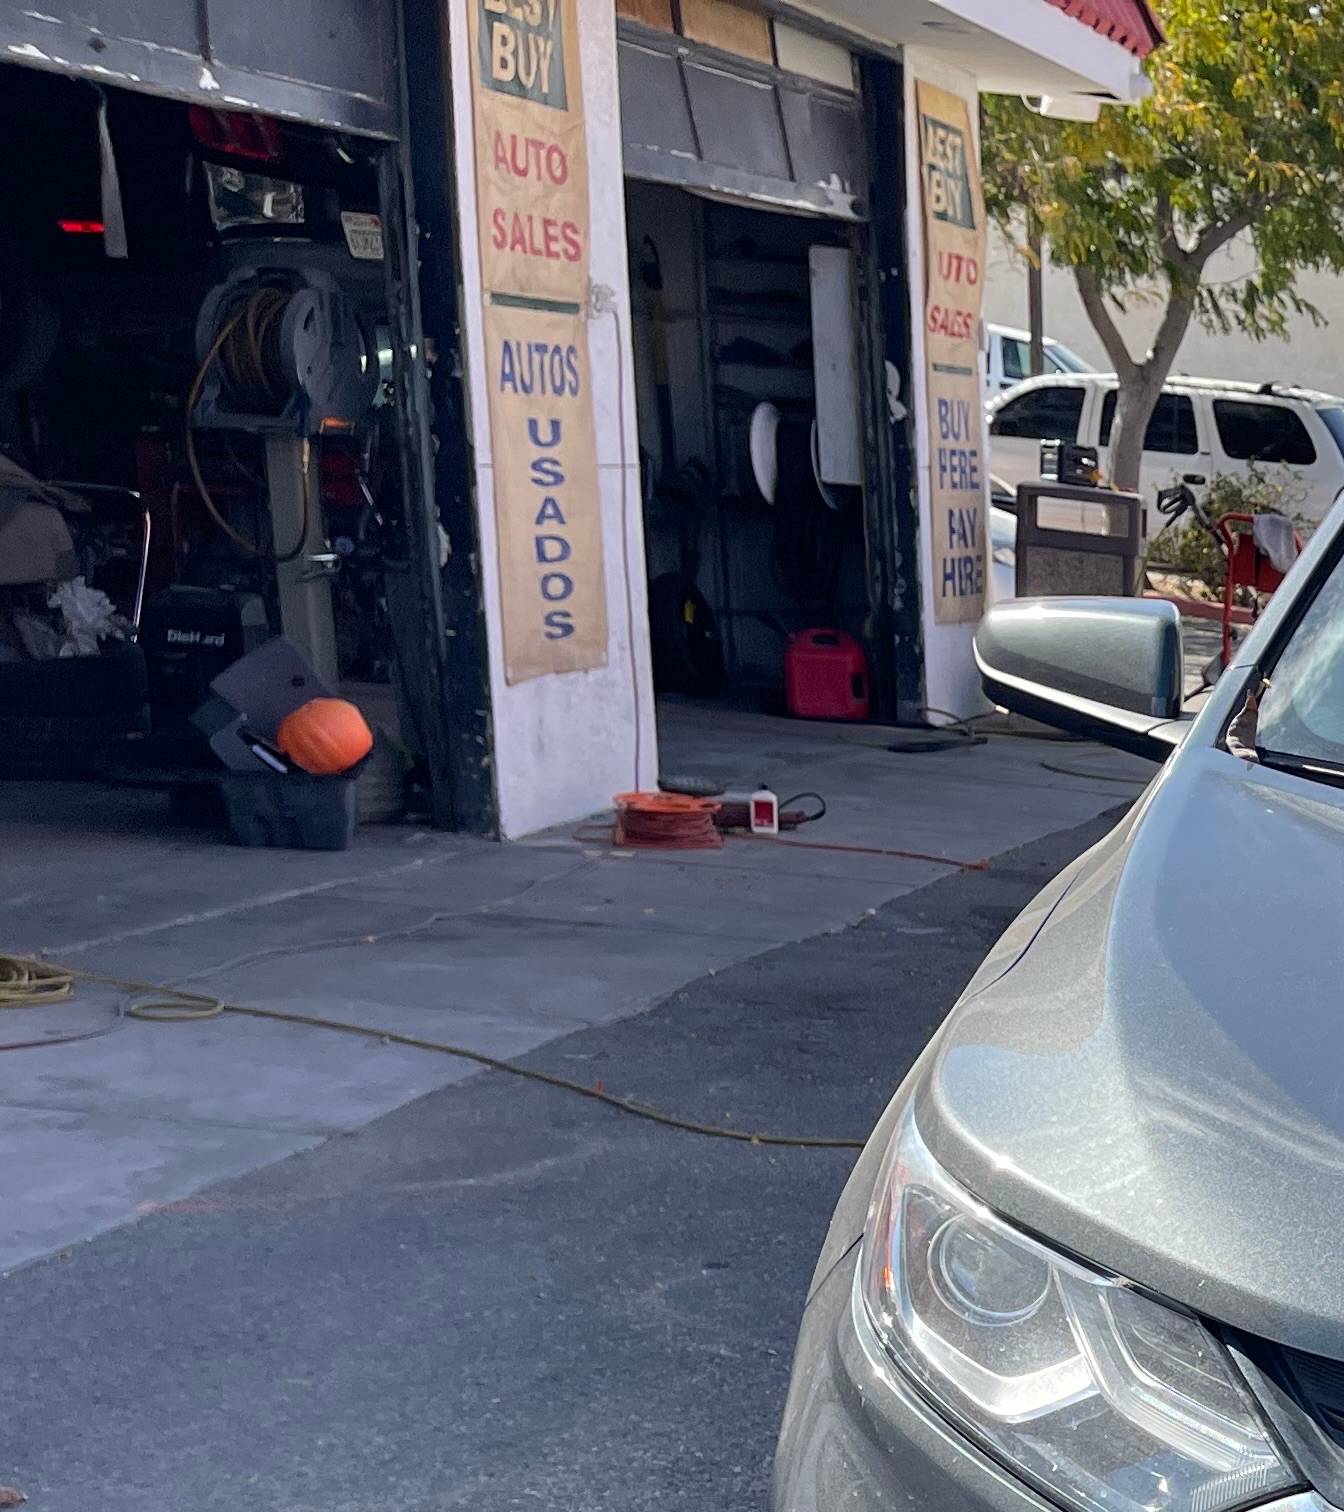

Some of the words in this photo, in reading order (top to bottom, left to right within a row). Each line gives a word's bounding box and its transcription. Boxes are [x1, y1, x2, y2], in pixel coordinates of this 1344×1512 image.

[491, 21, 553, 94] BUY
[493, 130, 569, 186] AUTO
[491, 206, 583, 263] SALES
[500, 338, 580, 398] AUTOS
[937, 397, 970, 442] BUY
[527, 417, 577, 641] USADOS
[947, 507, 978, 550] PAY
